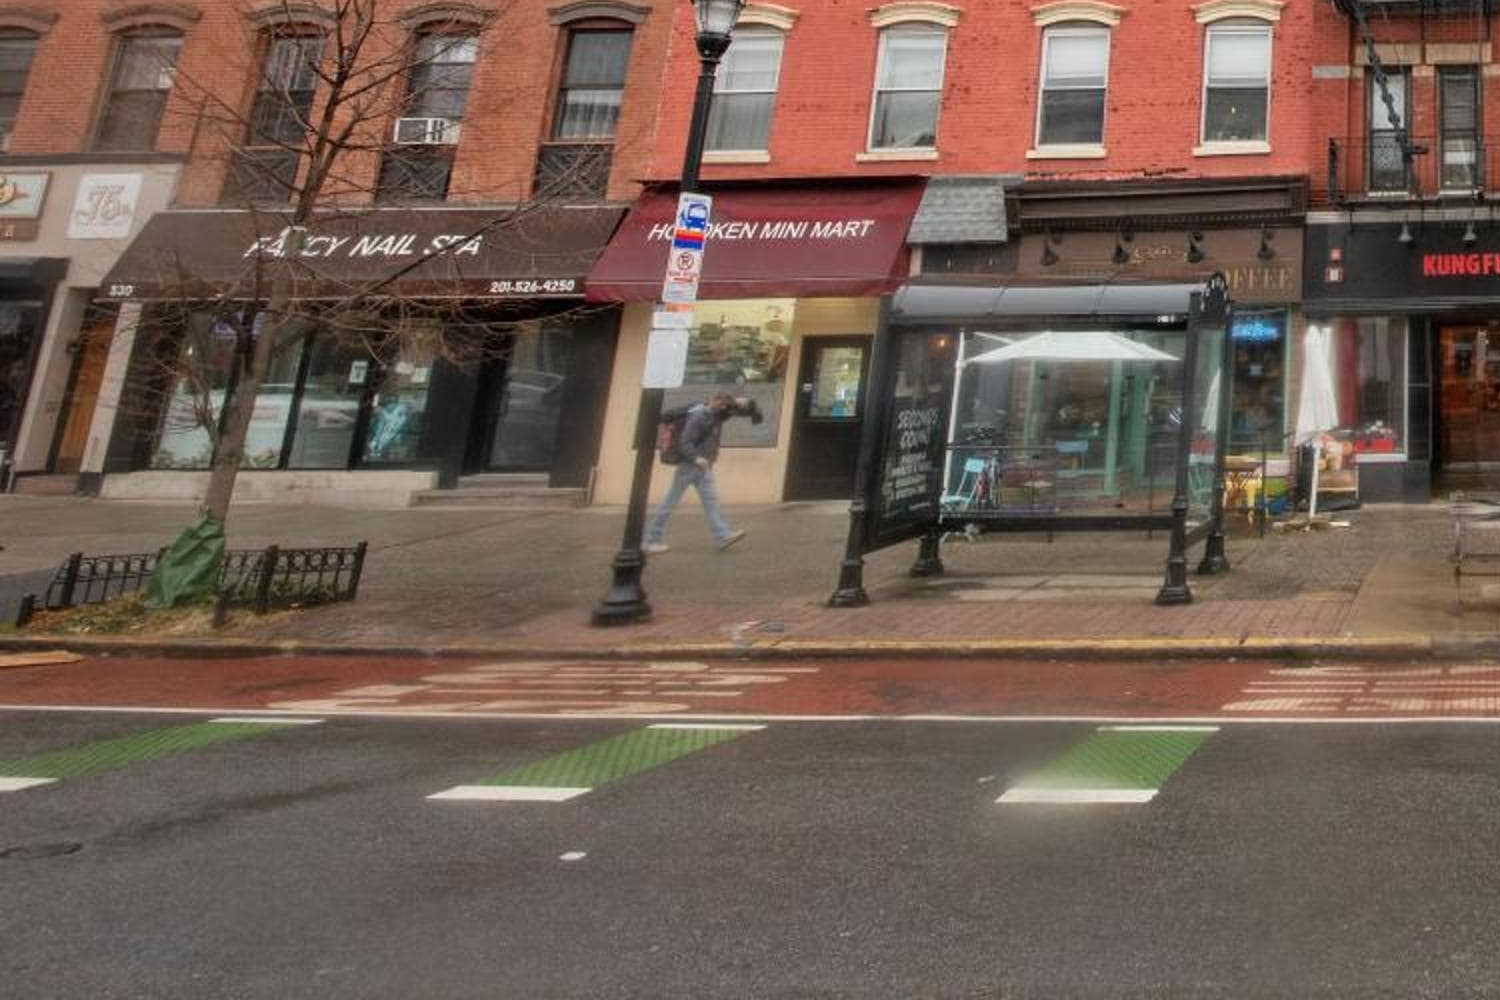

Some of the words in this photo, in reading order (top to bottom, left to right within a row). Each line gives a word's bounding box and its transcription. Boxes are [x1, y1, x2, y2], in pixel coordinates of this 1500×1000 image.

[648, 222, 758, 240] HOOKEN
[760, 221, 807, 239] MINI
[810, 220, 874, 238] MART
[243, 236, 350, 257] FACY
[349, 234, 416, 256] NAIL
